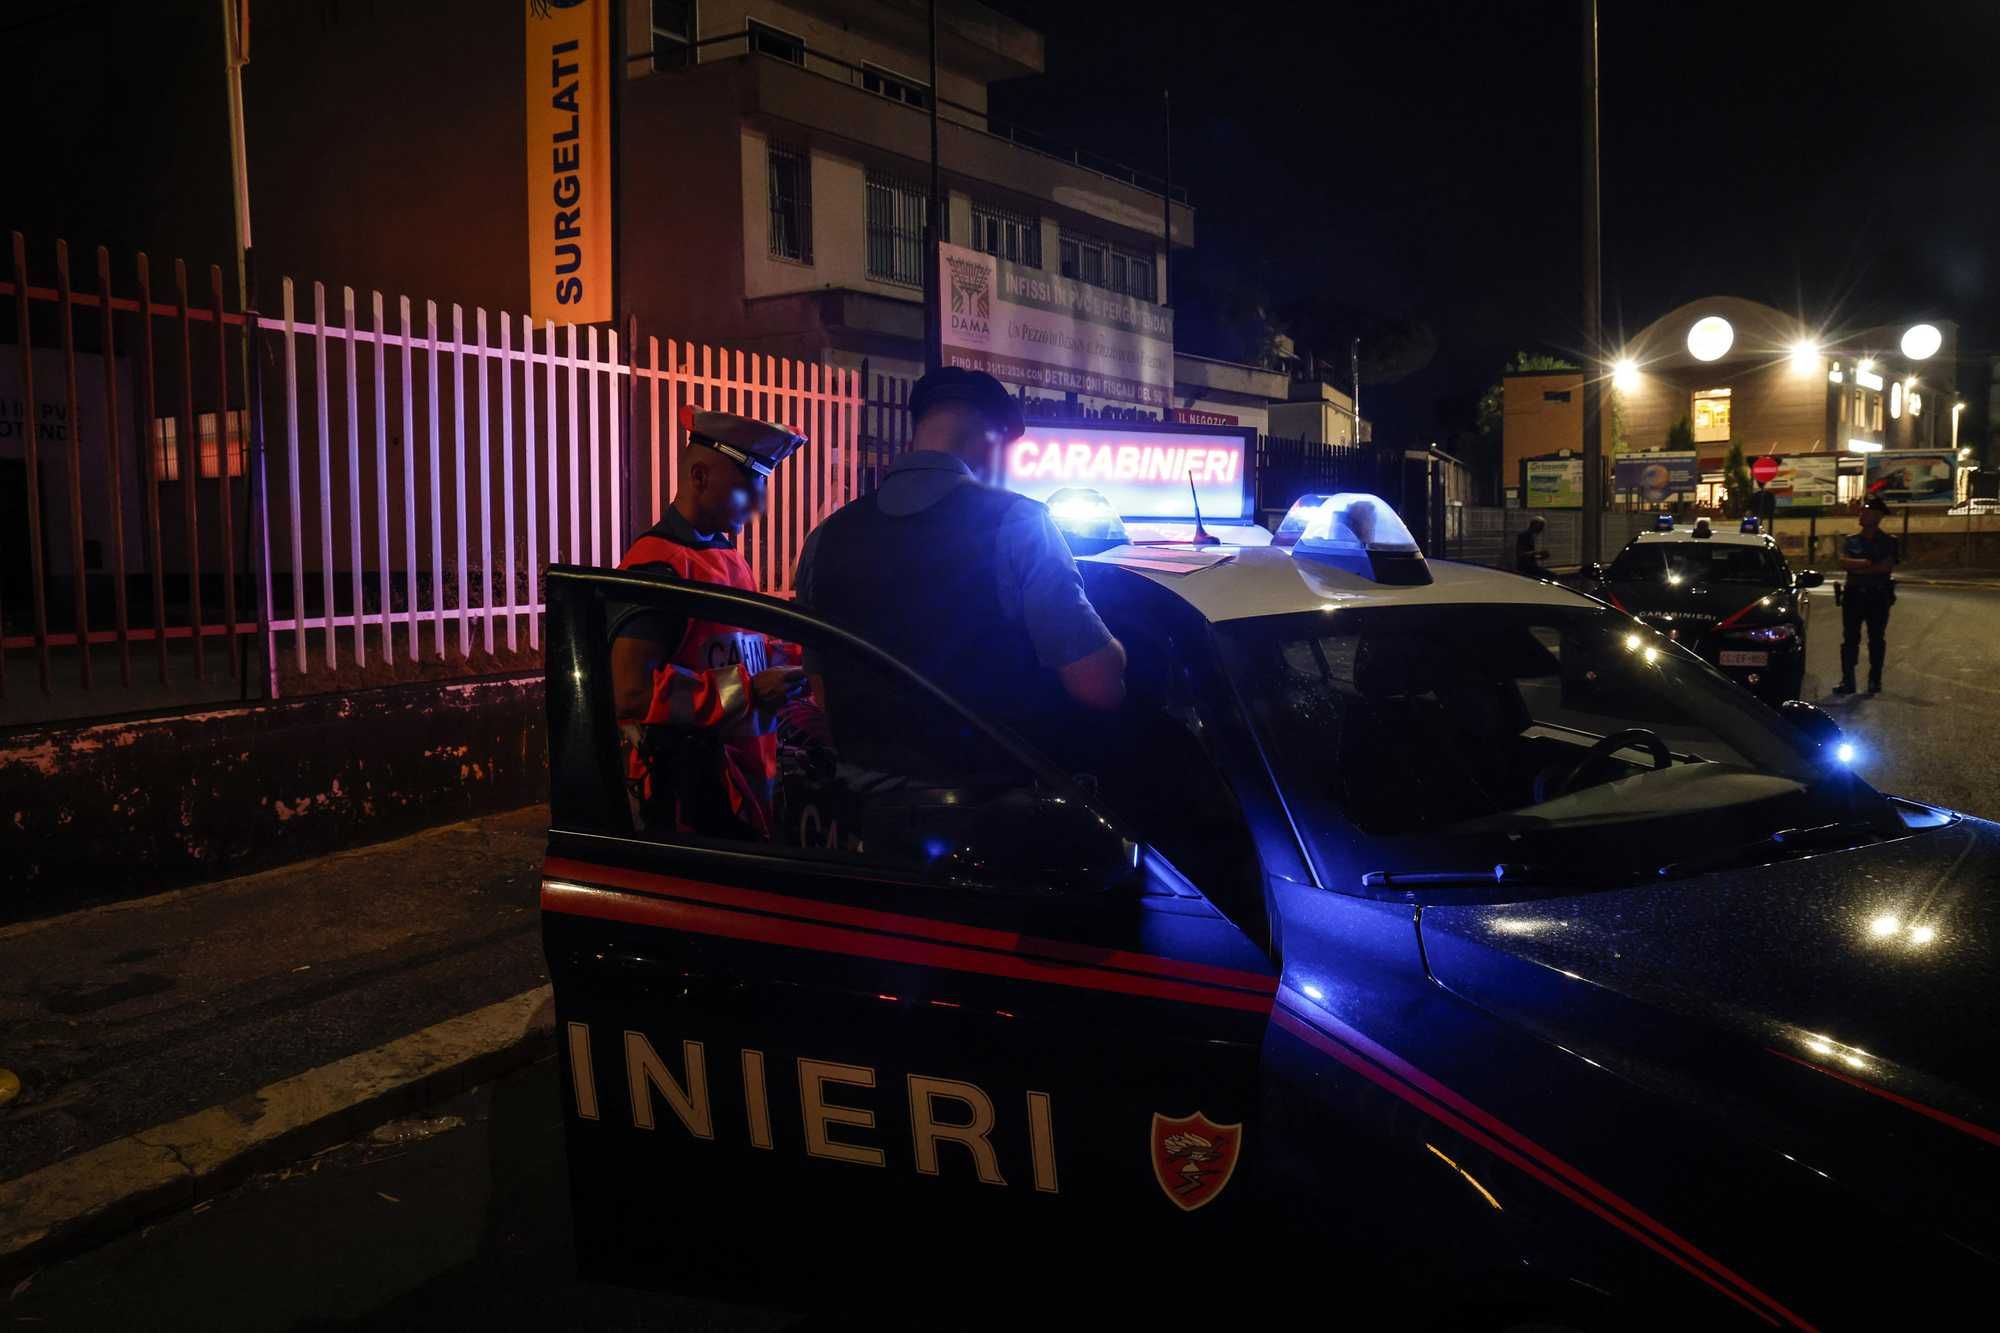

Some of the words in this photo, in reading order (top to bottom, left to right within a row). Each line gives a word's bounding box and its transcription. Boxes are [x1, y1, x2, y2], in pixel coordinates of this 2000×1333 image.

[552, 40, 583, 305] SURGELATI
[1006, 271, 1050, 304] INFISSI
[951, 315, 990, 334] DAMA
[951, 355, 971, 370] FINO
[1045, 368, 1100, 392] DETRAZIONI
[1103, 379, 1136, 398] FISCALI
[1010, 442, 1240, 481] CARABINIERI
[567, 1020, 1062, 1197] INIERI
